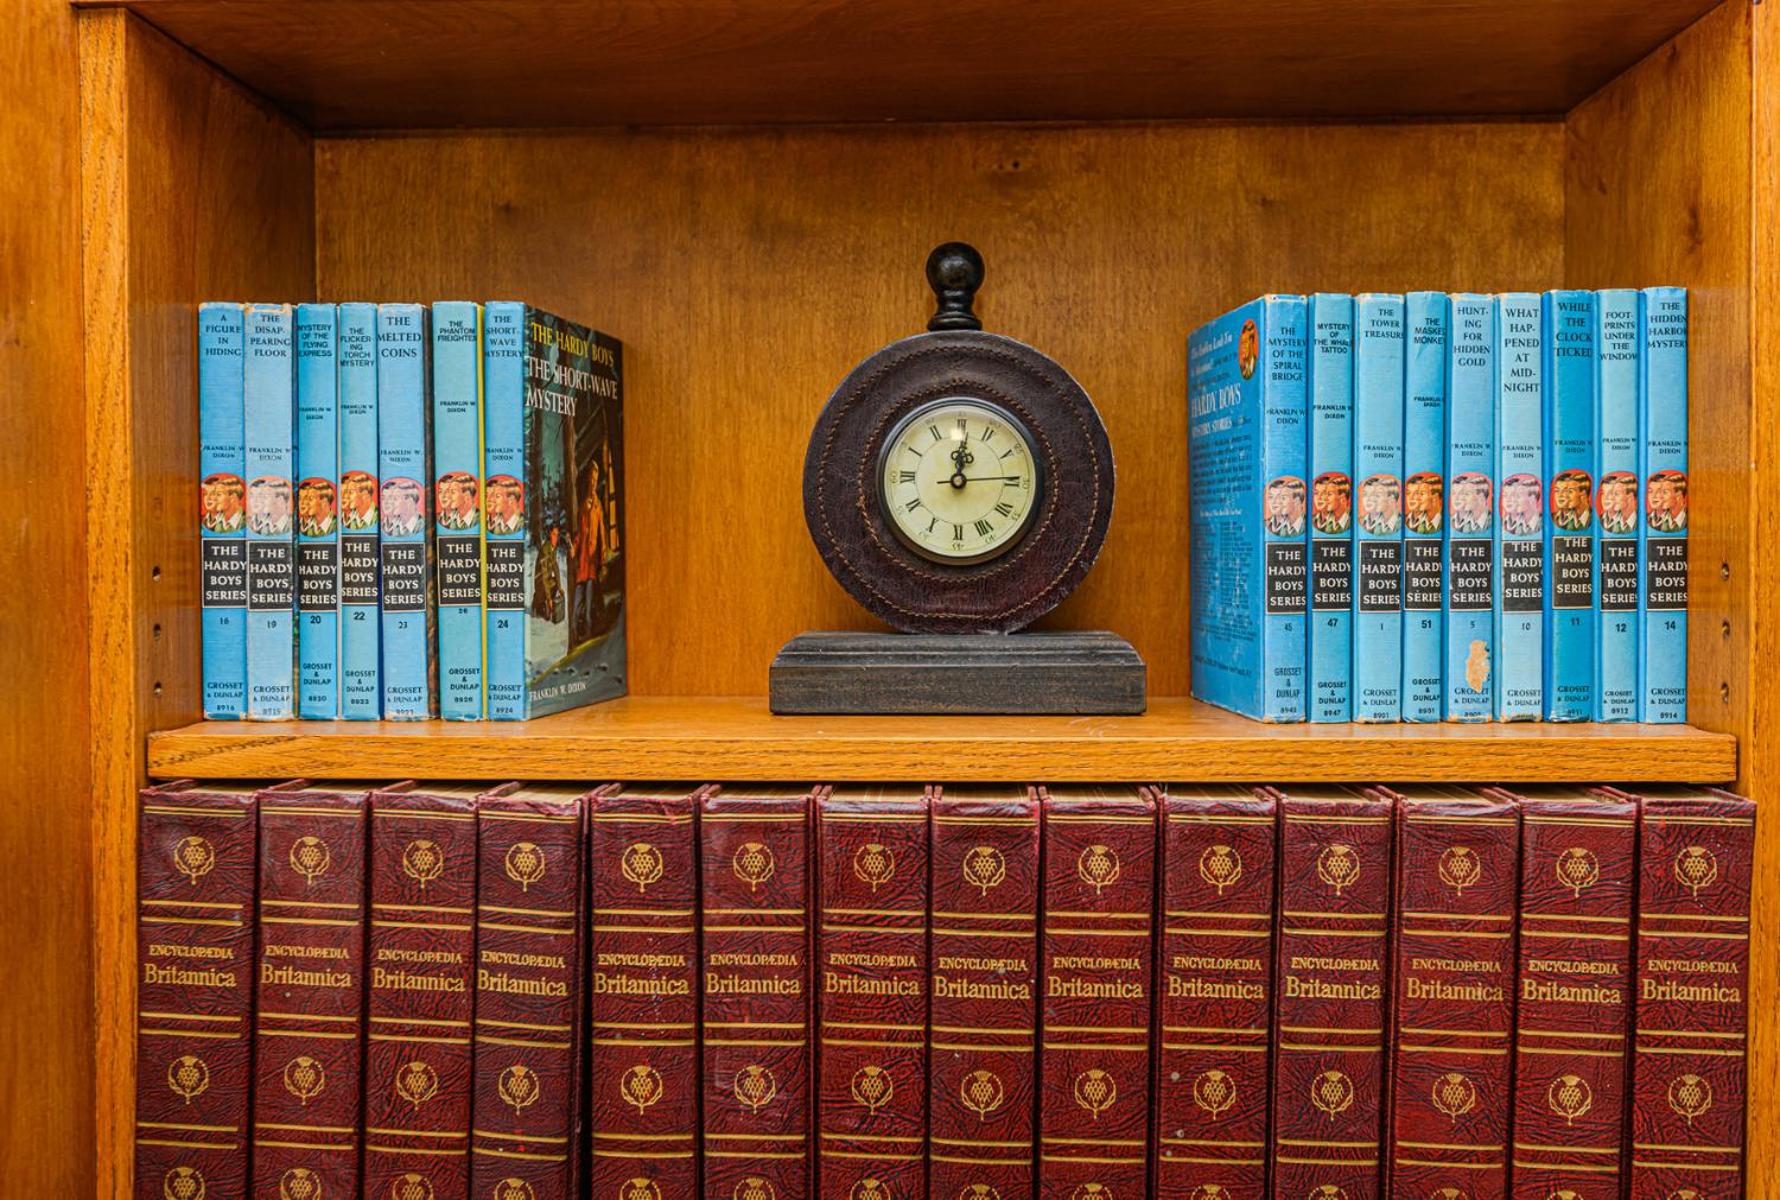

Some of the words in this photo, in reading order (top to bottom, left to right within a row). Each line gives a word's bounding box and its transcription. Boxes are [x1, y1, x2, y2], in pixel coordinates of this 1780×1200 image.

[1661, 302, 1680, 310] THE
[260, 314, 280, 322] THE
[1506, 309, 1538, 318] WHAT
[387, 316, 411, 326] THE
[1371, 319, 1400, 328] TOWER
[1464, 320, 1482, 328] ING
[1565, 318, 1585, 327] THE
[206, 325, 241, 333] FIGURE
[1280, 327, 1296, 335] THE
[1463, 332, 1482, 341] FOR
[1556, 333, 1592, 342] CLOCK
[1604, 332, 1635, 340] UNDER
[250, 337, 291, 345] PEARING
[303, 341, 328, 349] FLYING
[531, 322, 553, 344] THE
[555, 331, 590, 358] HARDY
[592, 344, 615, 367] BOYS
[1505, 339, 1539, 347] PENED
[1454, 345, 1490, 354] HIDDEN
[1612, 342, 1629, 350] THE
[255, 349, 286, 357] FLOOR
[381, 349, 417, 357] COINS
[1458, 358, 1485, 366] GOLD
[1515, 354, 1529, 362] AT
[527, 355, 549, 381] THE
[1504, 383, 1540, 392] NIGHT
[526, 388, 577, 417] MYSTERY
[212, 546, 238, 555] THE
[447, 544, 472, 553] THE
[491, 548, 516, 558] THE
[1321, 547, 1346, 556] THE
[1459, 547, 1485, 556] THE
[1657, 546, 1683, 556] THE
[257, 549, 285, 558] THE
[389, 550, 415, 560] THE
[1276, 551, 1301, 560] THE
[1370, 549, 1394, 558] THE
[205, 560, 246, 570] HARDY
[440, 559, 480, 568] HARDY
[1451, 562, 1492, 572] HARDY
[251, 564, 292, 573] HARDY
[446, 573, 476, 583] BOYS
[1510, 573, 1539, 582] BOYS
[1562, 568, 1589, 579] BOYS
[211, 576, 242, 585] BOYS
[257, 579, 289, 588] BOYS
[388, 580, 419, 589] BOYS
[491, 578, 520, 588] BOYS
[1320, 578, 1348, 587] BOYS
[1368, 580, 1397, 589] BOYS
[1458, 578, 1487, 587] BOYS
[1655, 577, 1685, 587] BOYS
[1275, 581, 1303, 590] BOYS
[206, 591, 246, 600] SERIES
[442, 588, 480, 598] SERIES
[487, 593, 523, 602] SERIES
[1453, 593, 1491, 602] SERIES
[252, 594, 292, 603] SERIES
[384, 595, 423, 604] SERIES
[310, 616, 321, 624] 20
[354, 612, 365, 620] 22
[220, 617, 229, 625] 16
[497, 620, 509, 629] 24
[1327, 619, 1338, 627] 47
[1421, 620, 1432, 629] 51
[1571, 618, 1580, 626] 11
[1665, 621, 1676, 630] 14
[1615, 624, 1626, 632] 12
[144, 964, 237, 989] Britannica
[260, 964, 352, 989] Britannica
[373, 968, 465, 992] Britannica
[476, 970, 568, 997] Britannica
[594, 973, 688, 996] Britannica
[706, 973, 800, 995] Britannica
[825, 973, 920, 996] Britannica
[1048, 977, 1143, 999] Britannica
[1168, 976, 1264, 1000] Britannica
[1285, 977, 1381, 999] Britannica
[935, 977, 1030, 1000] Britannica
[1407, 978, 1504, 1001] Britannica
[1522, 979, 1621, 1003] Britannica
[1642, 978, 1741, 1003] Britannica
